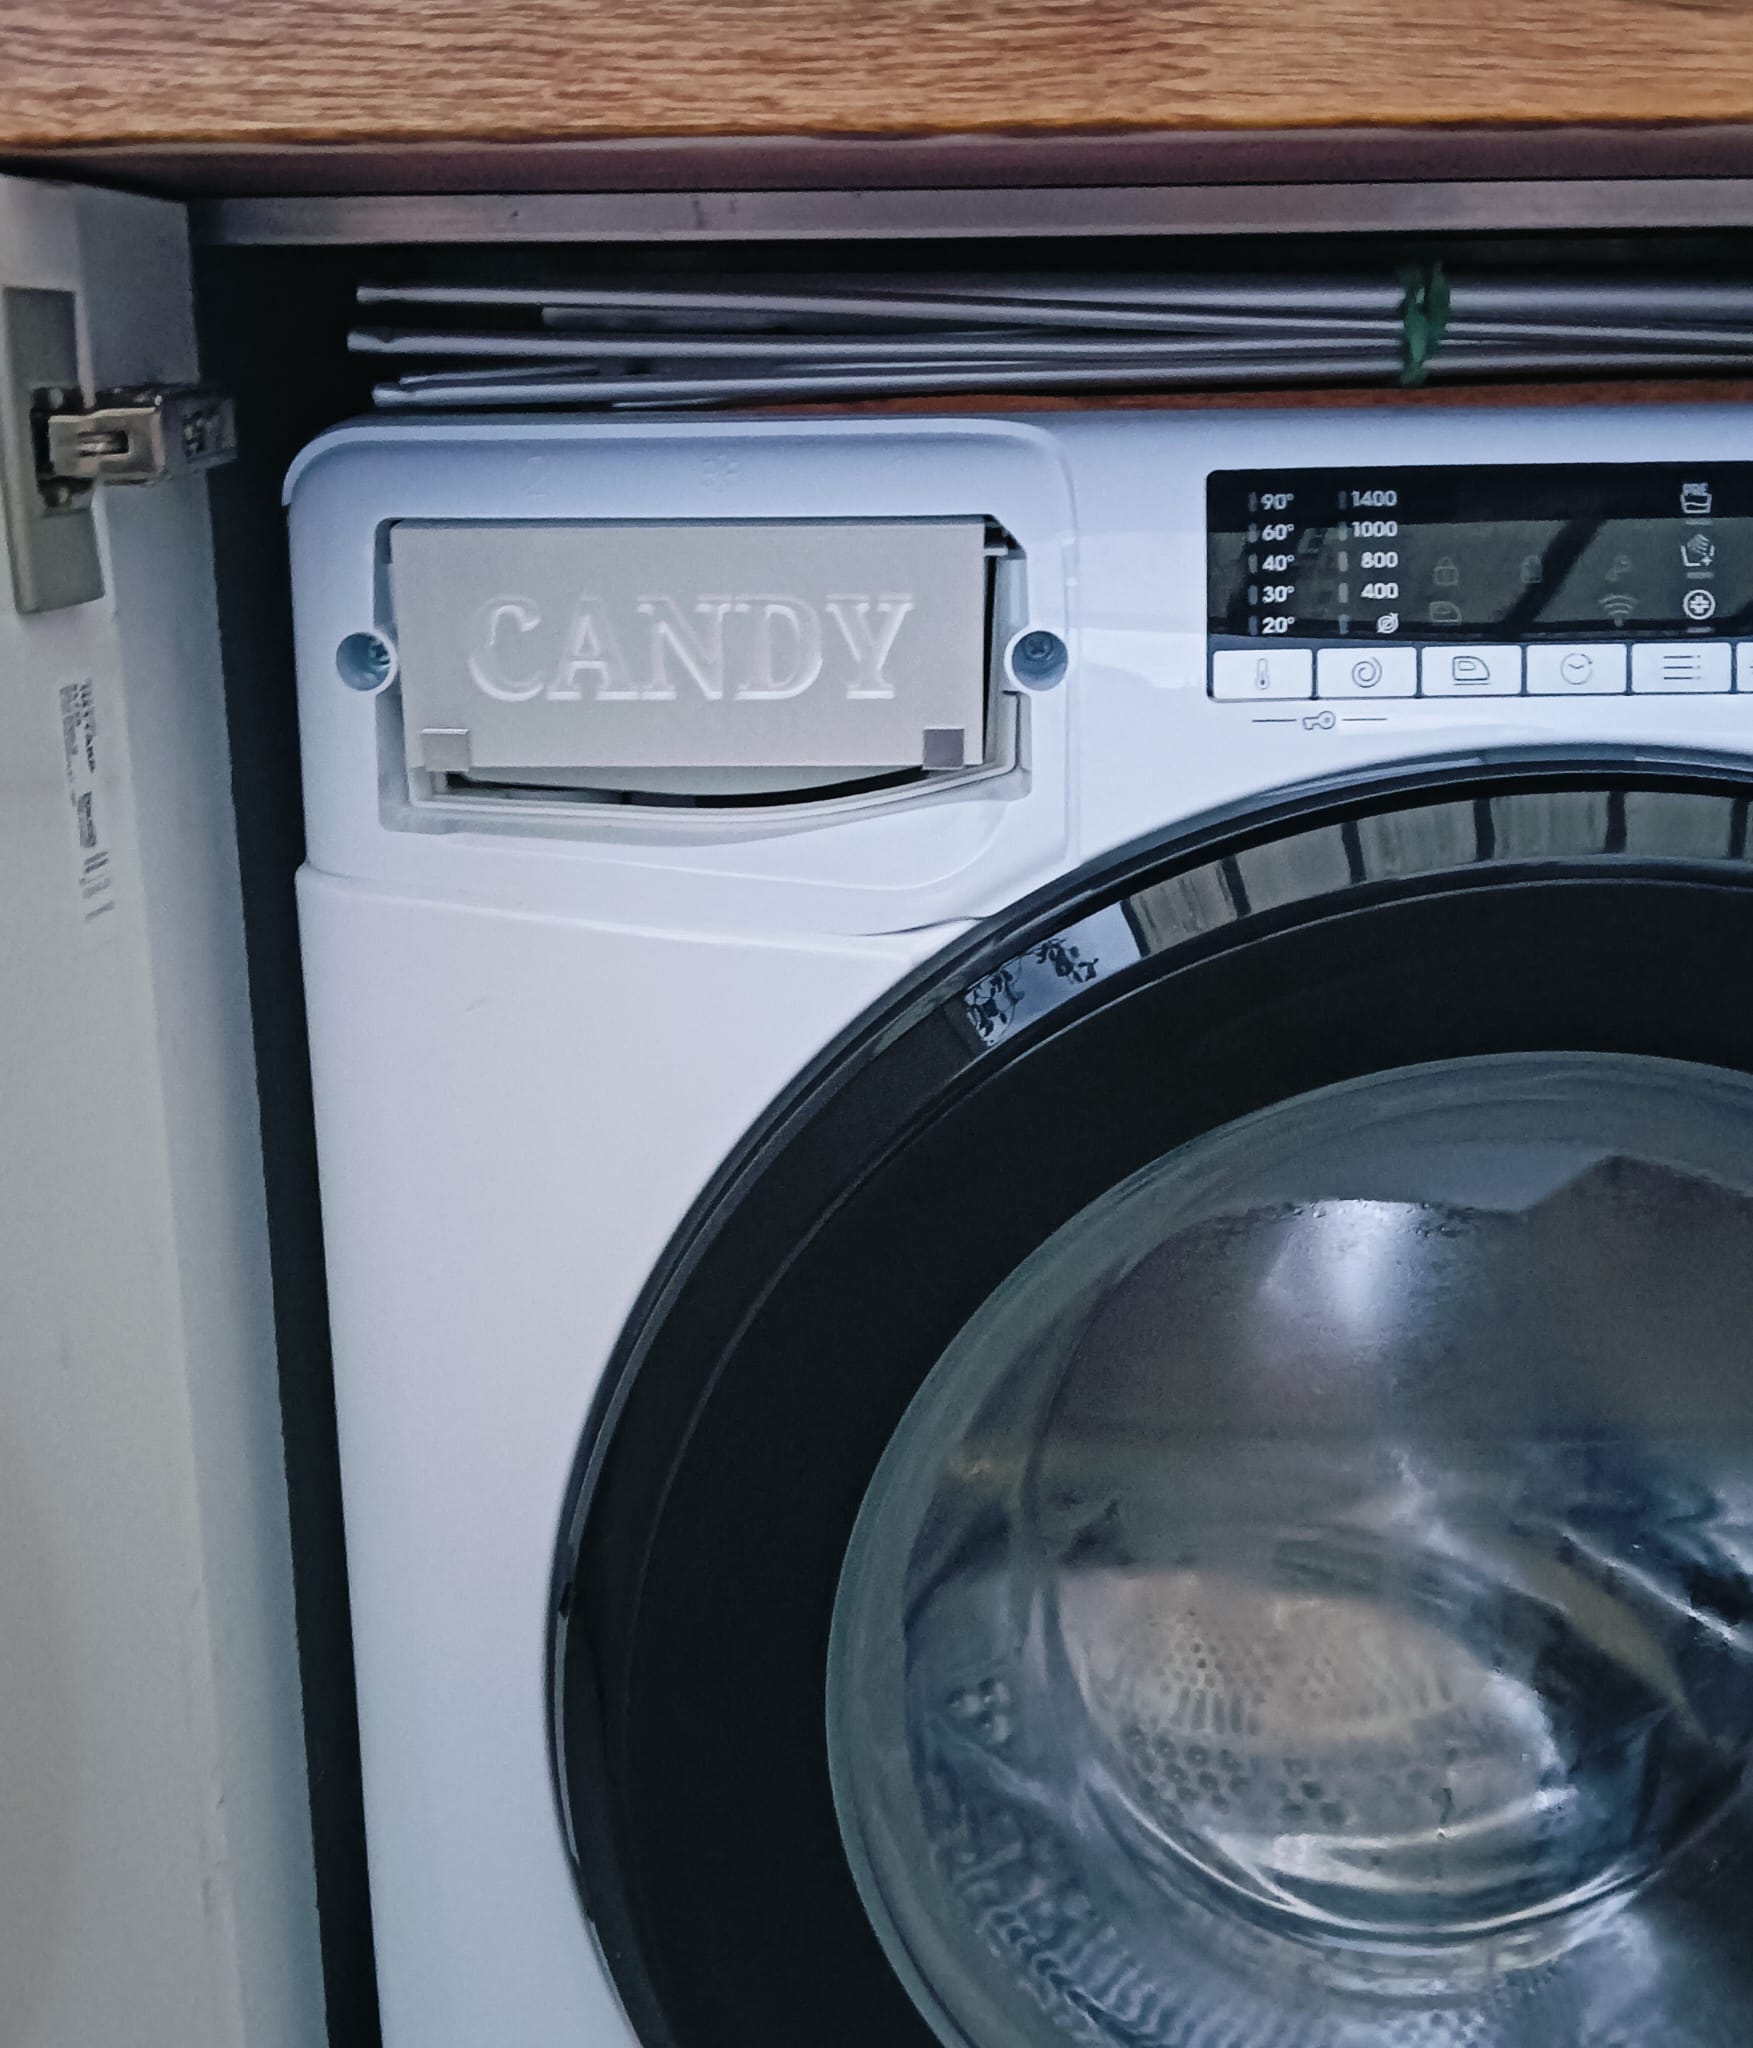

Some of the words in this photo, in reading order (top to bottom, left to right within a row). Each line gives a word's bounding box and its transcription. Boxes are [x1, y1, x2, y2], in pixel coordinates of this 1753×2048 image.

[1260, 493, 1295, 510] 90°
[1351, 490, 1398, 507] 1400
[1261, 523, 1295, 541] 60°
[1351, 521, 1398, 538] 1000
[1261, 554, 1296, 571] 40°
[1360, 551, 1399, 568] 800
[1261, 585, 1296, 604] 30°
[1360, 582, 1399, 599] 400
[1261, 616, 1296, 634] 20°
[468, 593, 916, 701] CANDY
